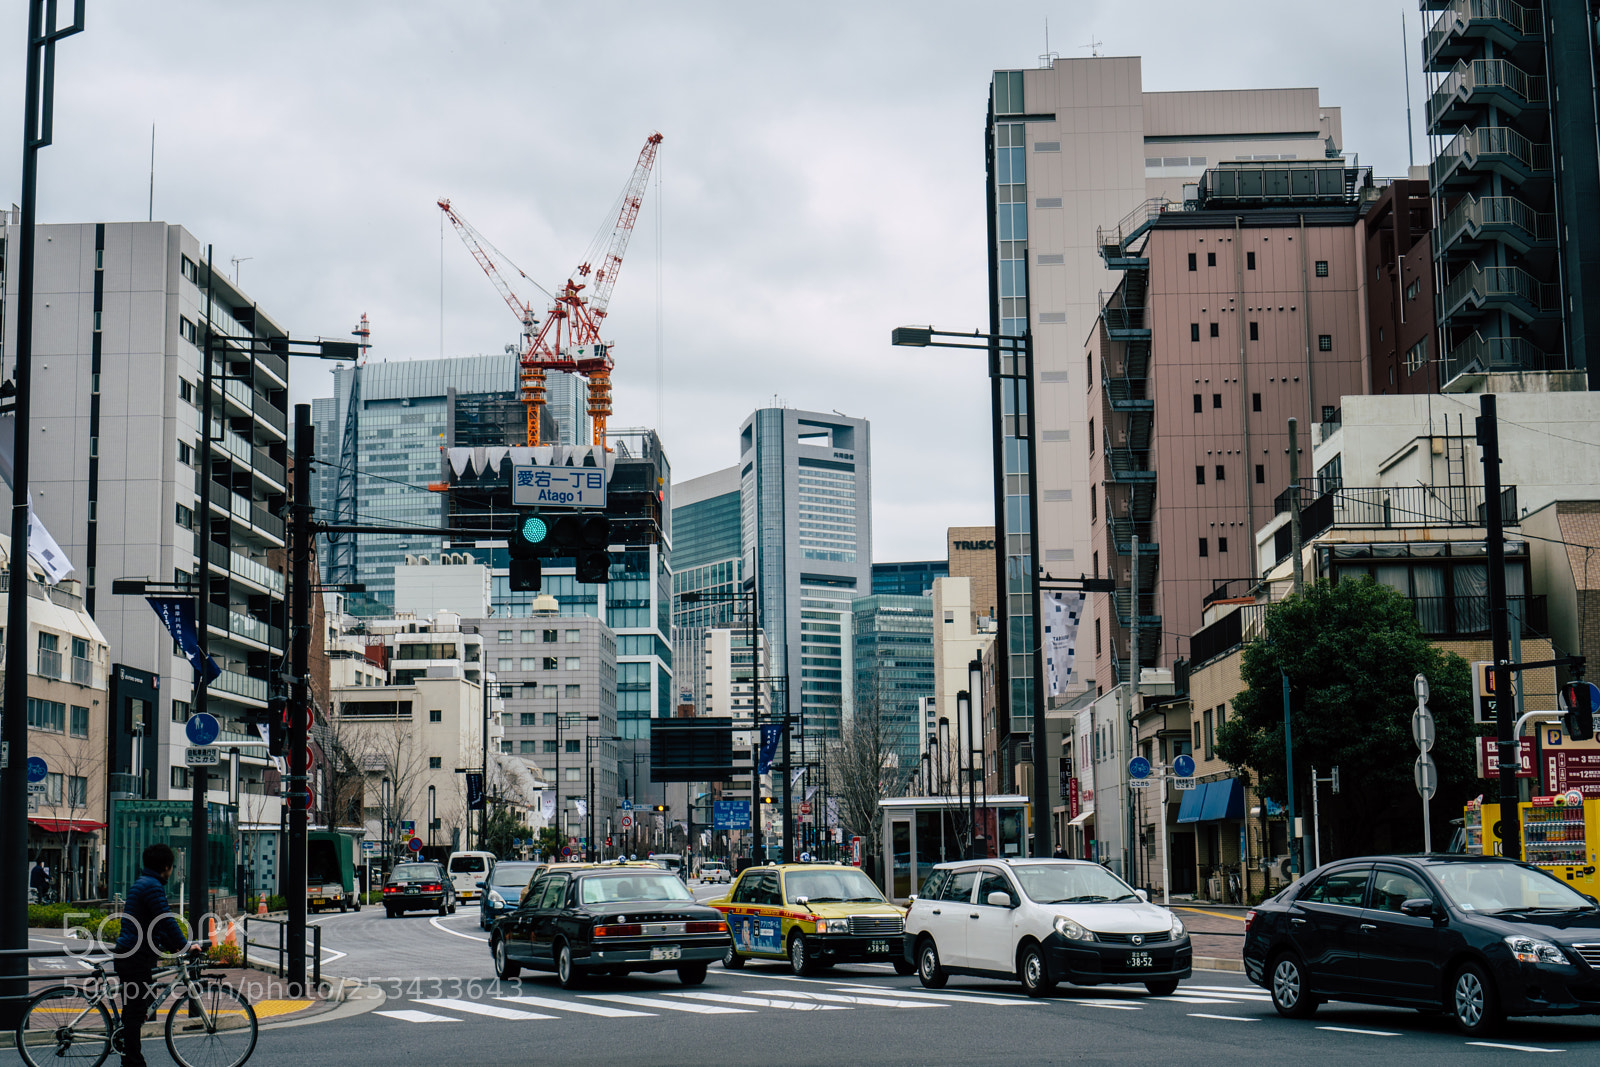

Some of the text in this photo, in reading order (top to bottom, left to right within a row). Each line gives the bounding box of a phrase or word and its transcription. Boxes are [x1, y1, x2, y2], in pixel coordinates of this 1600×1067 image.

[517, 470, 602, 489] 愛宕一丁目
[538, 489, 583, 503] Atago 1
[953, 540, 996, 551] TRUSC
[1132, 957, 1152, 966] 38-52
